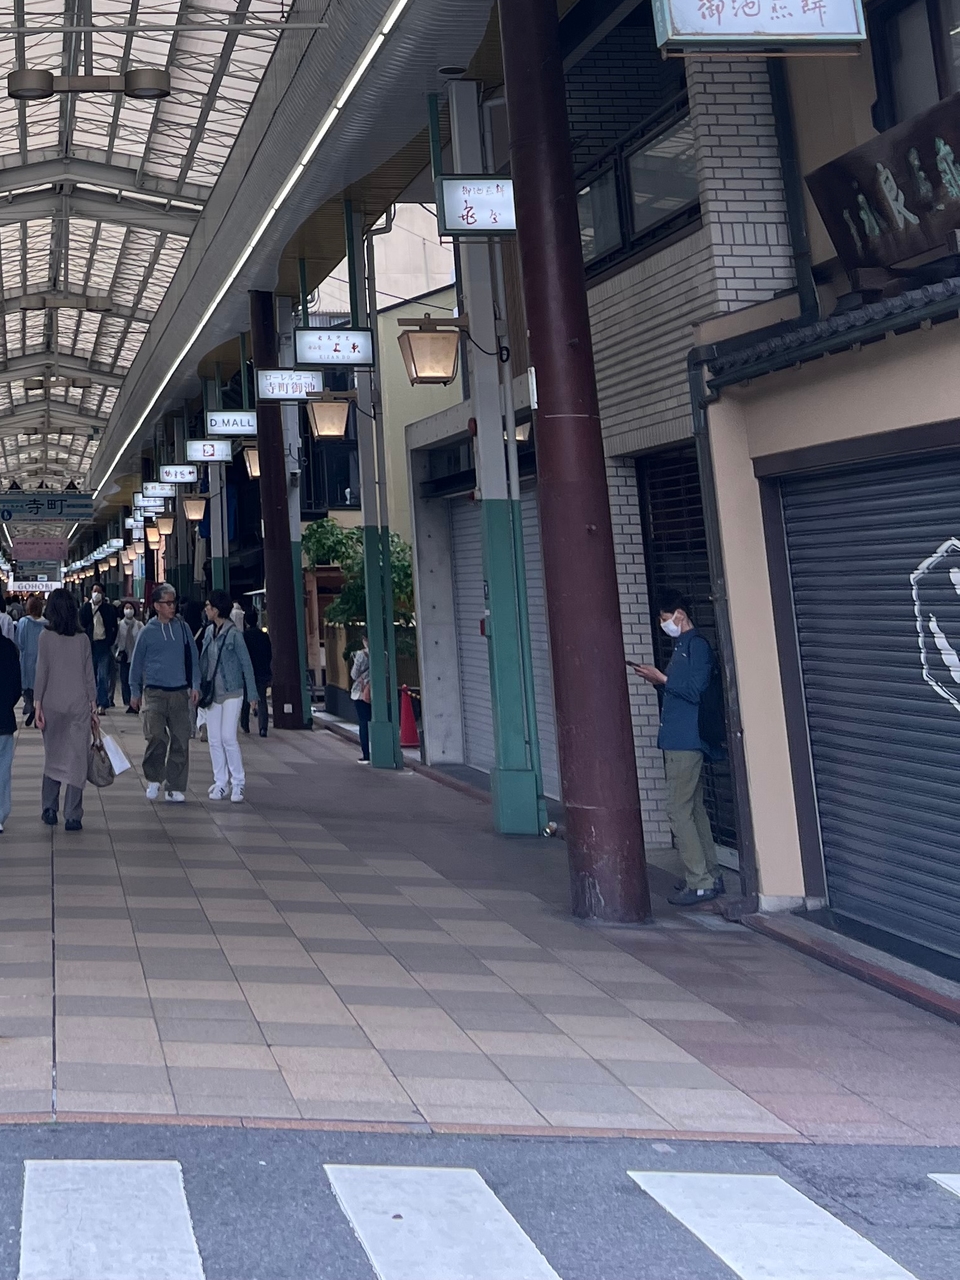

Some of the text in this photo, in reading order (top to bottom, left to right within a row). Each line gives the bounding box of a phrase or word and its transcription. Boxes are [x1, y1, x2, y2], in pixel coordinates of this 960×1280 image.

[265, 382, 316, 395] 寺町御池
[25, 498, 68, 515] 寺町
